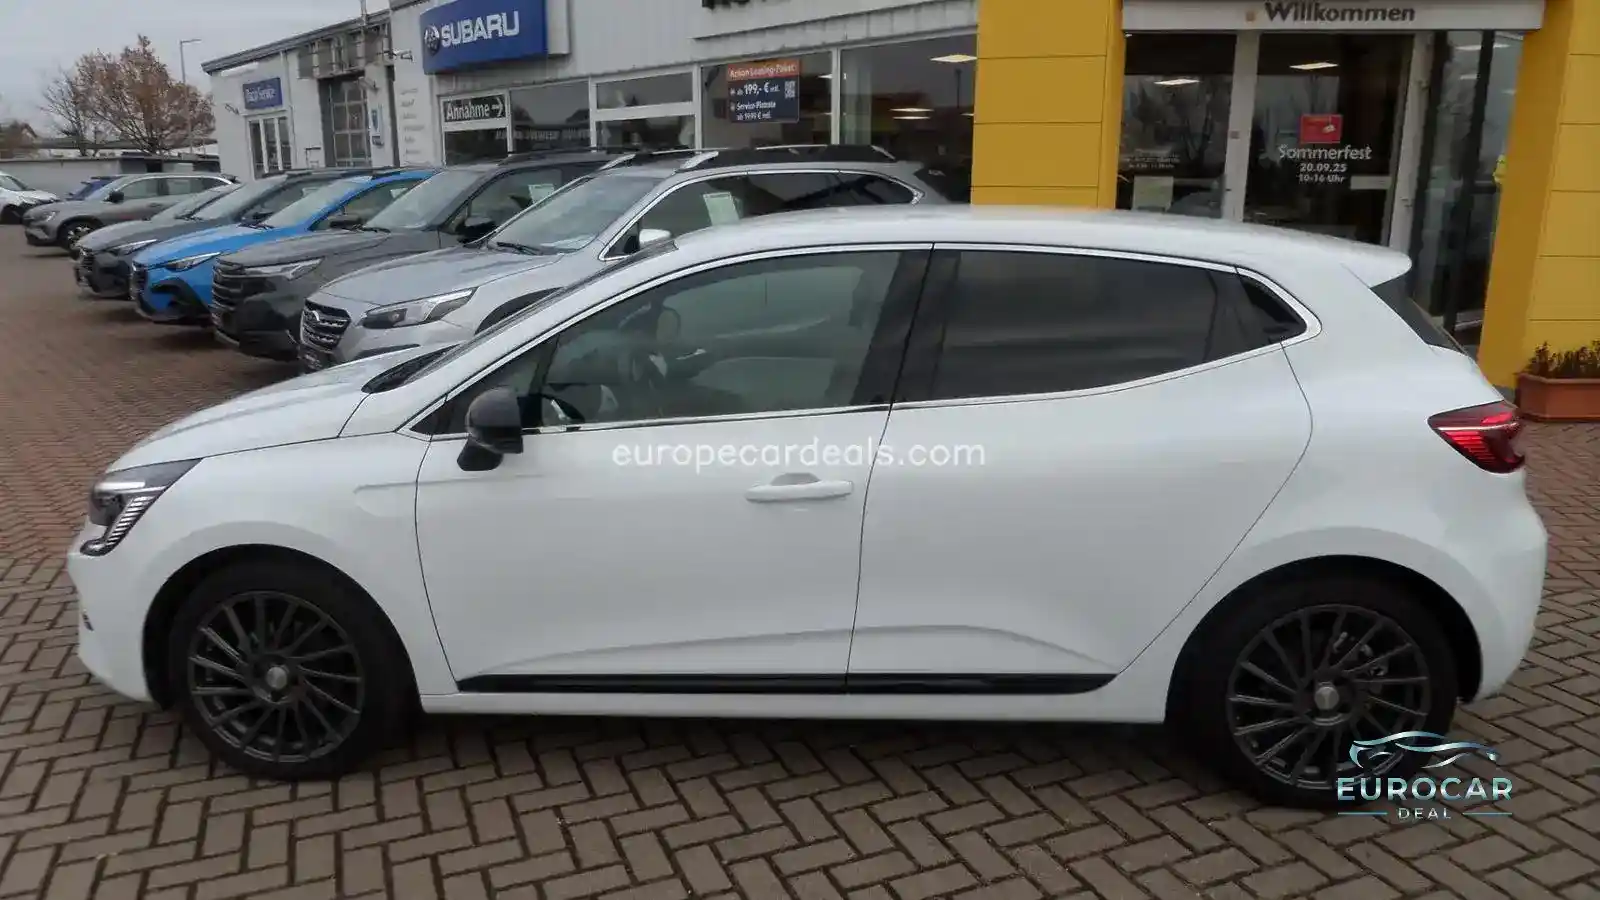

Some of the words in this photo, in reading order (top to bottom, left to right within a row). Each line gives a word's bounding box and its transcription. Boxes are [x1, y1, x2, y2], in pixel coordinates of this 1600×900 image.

[1265, 1, 1416, 22] Willkommen
[441, 10, 520, 48] SUBARU
[763, 81, 770, 93] €
[446, 101, 490, 120] Annahme
[1279, 145, 1373, 160] Sommerfest
[1300, 162, 1348, 172] 20.09.25
[1327, 174, 1346, 182] Uhr
